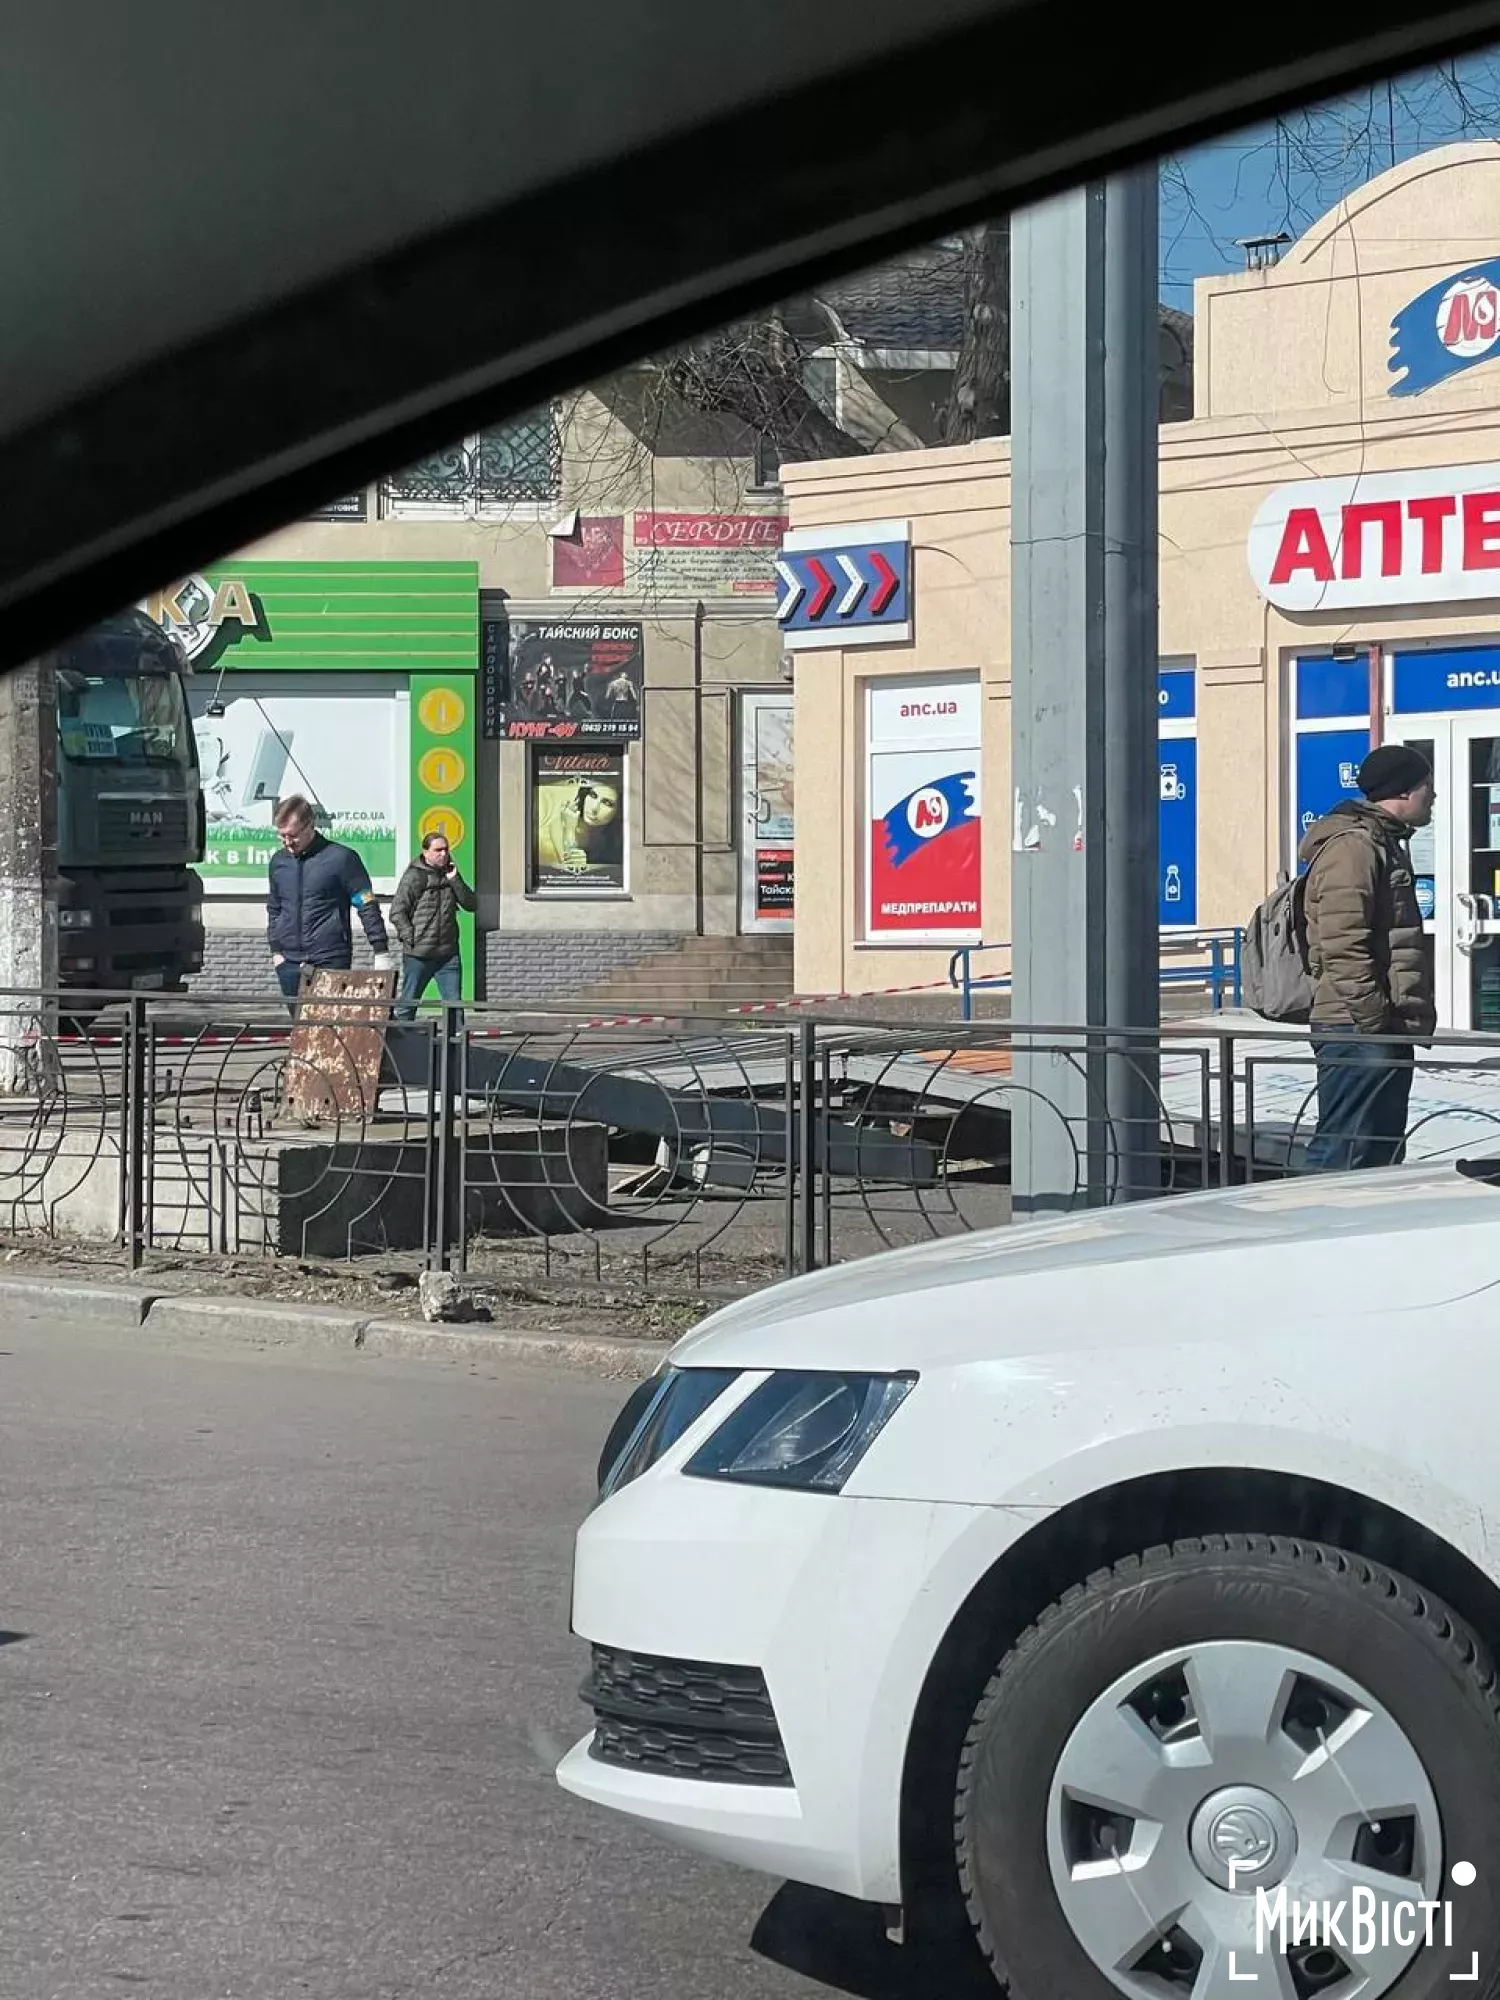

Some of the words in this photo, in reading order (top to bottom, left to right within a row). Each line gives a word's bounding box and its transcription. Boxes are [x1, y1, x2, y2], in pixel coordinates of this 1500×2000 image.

[651, 519, 780, 546] СЕРДЦЕ
[538, 624, 600, 640] ТАЙСКИЙ
[602, 627, 639, 640] БОКС
[899, 700, 957, 718] anc.ua
[130, 811, 163, 824] MAN
[880, 900, 978, 917] МЕДПРЕПАРАТИ
